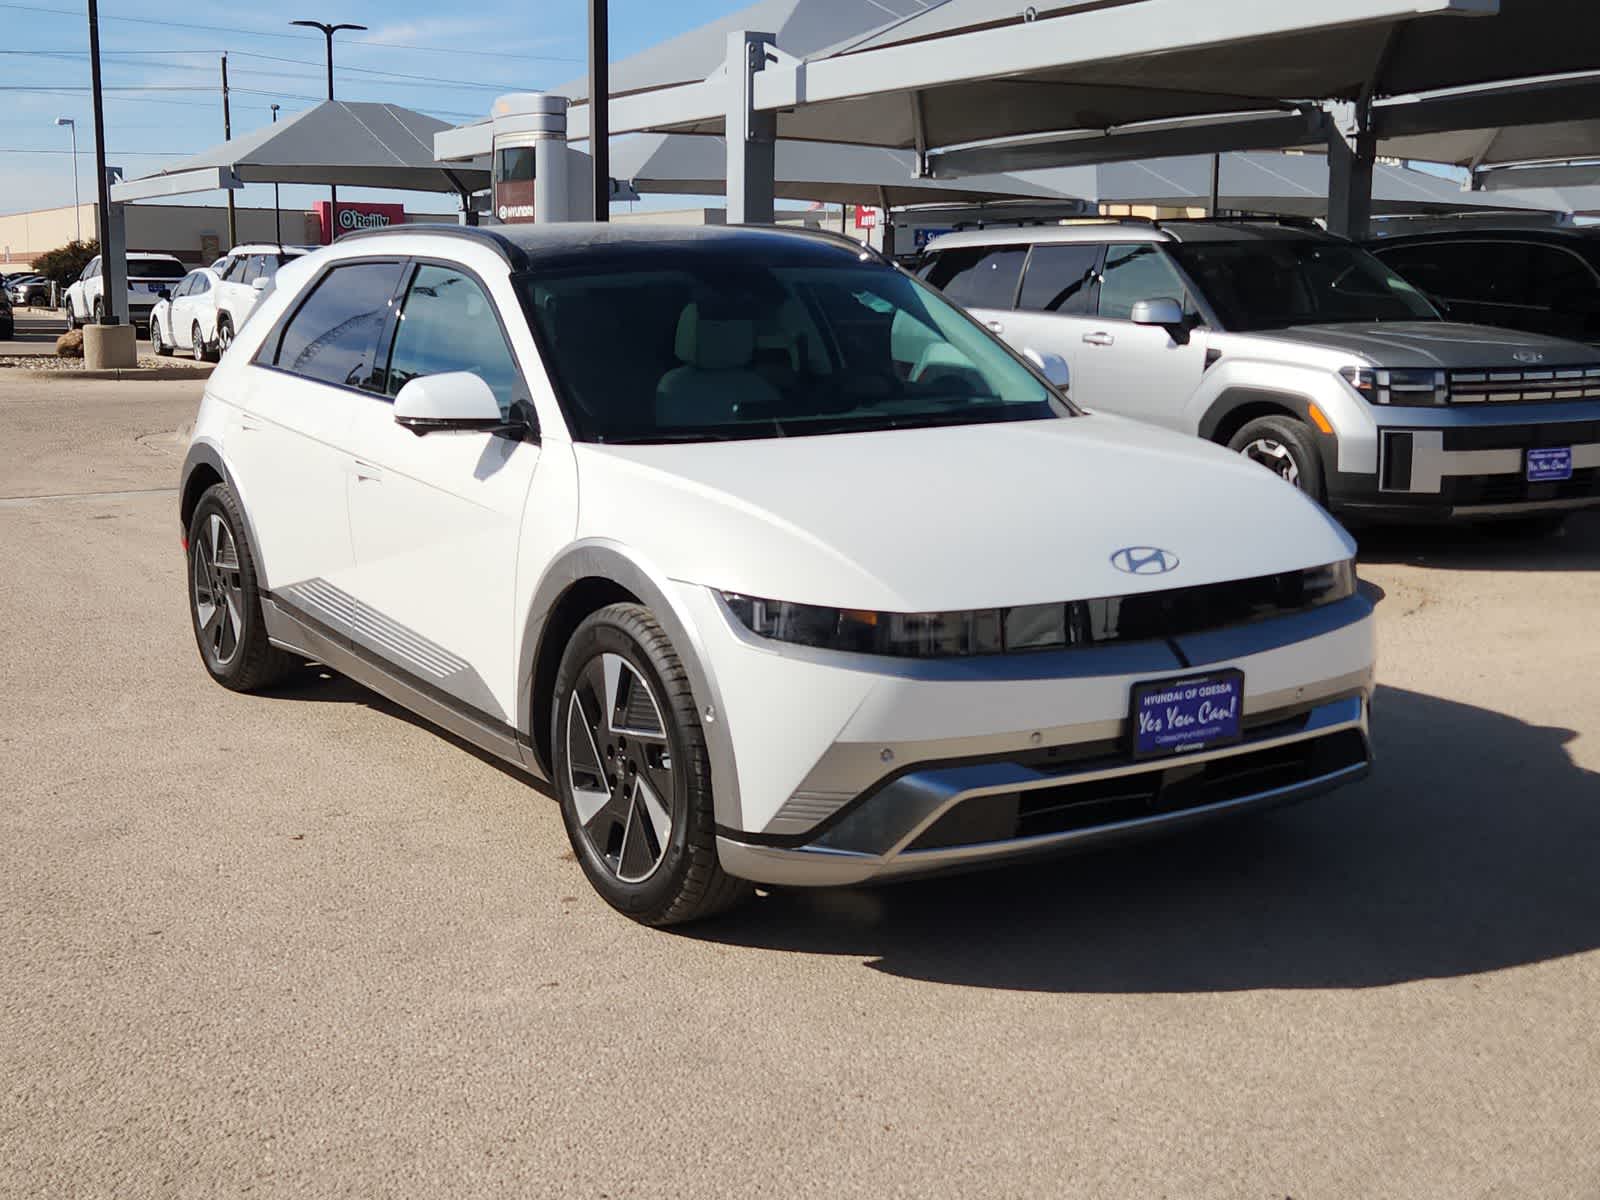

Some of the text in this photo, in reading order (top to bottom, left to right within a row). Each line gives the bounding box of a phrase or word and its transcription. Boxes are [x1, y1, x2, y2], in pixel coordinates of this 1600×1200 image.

[340, 210, 390, 229] O'Reilly
[1144, 683, 1232, 706] HYUNDAI OF ODESSA
[1139, 696, 1236, 734] Yes You Can!
